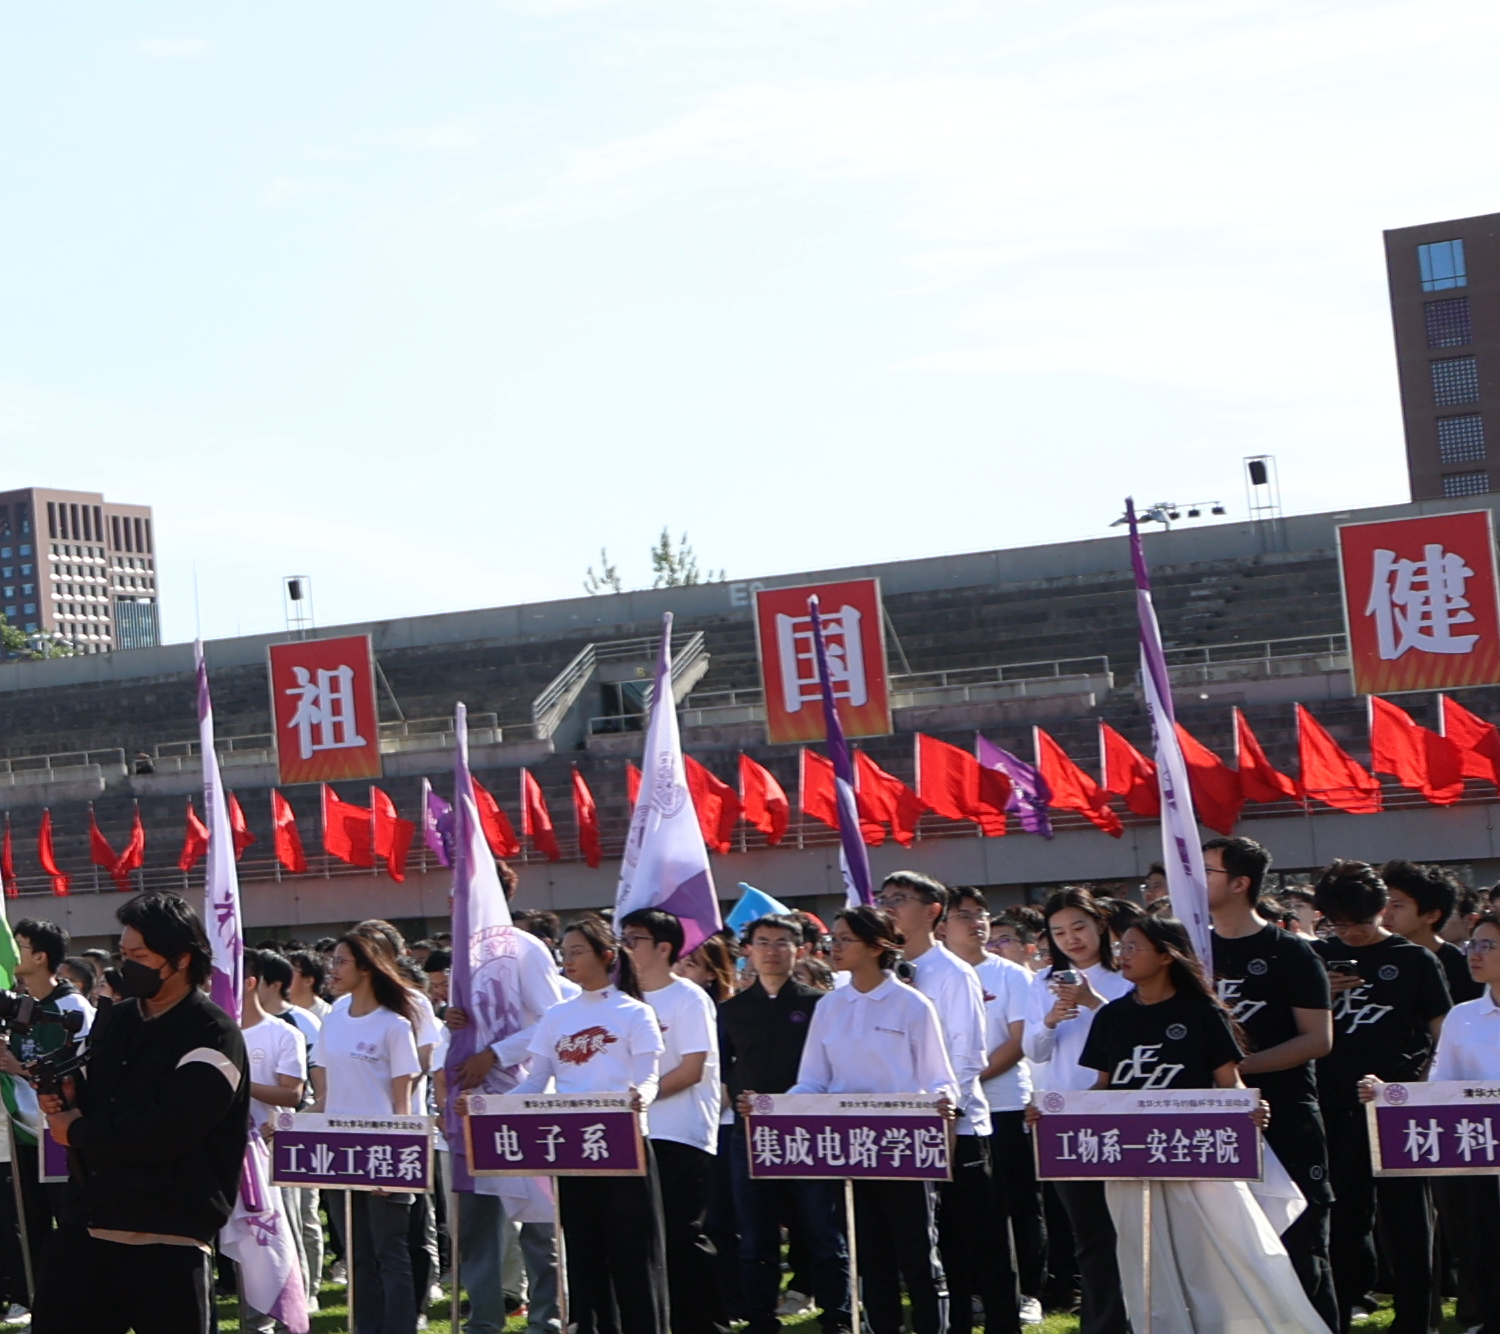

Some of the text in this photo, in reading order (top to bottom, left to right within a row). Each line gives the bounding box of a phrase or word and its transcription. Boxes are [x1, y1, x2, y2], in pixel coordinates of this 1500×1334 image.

[1363, 543, 1481, 661] 健
[775, 604, 869, 714] 国
[284, 664, 368, 760] 祖
[281, 1142, 423, 1182] 工业工程系
[494, 1122, 611, 1163] 电子系
[752, 1125, 948, 1169] 集成电路学院
[1402, 1117, 1500, 1163] 材料
